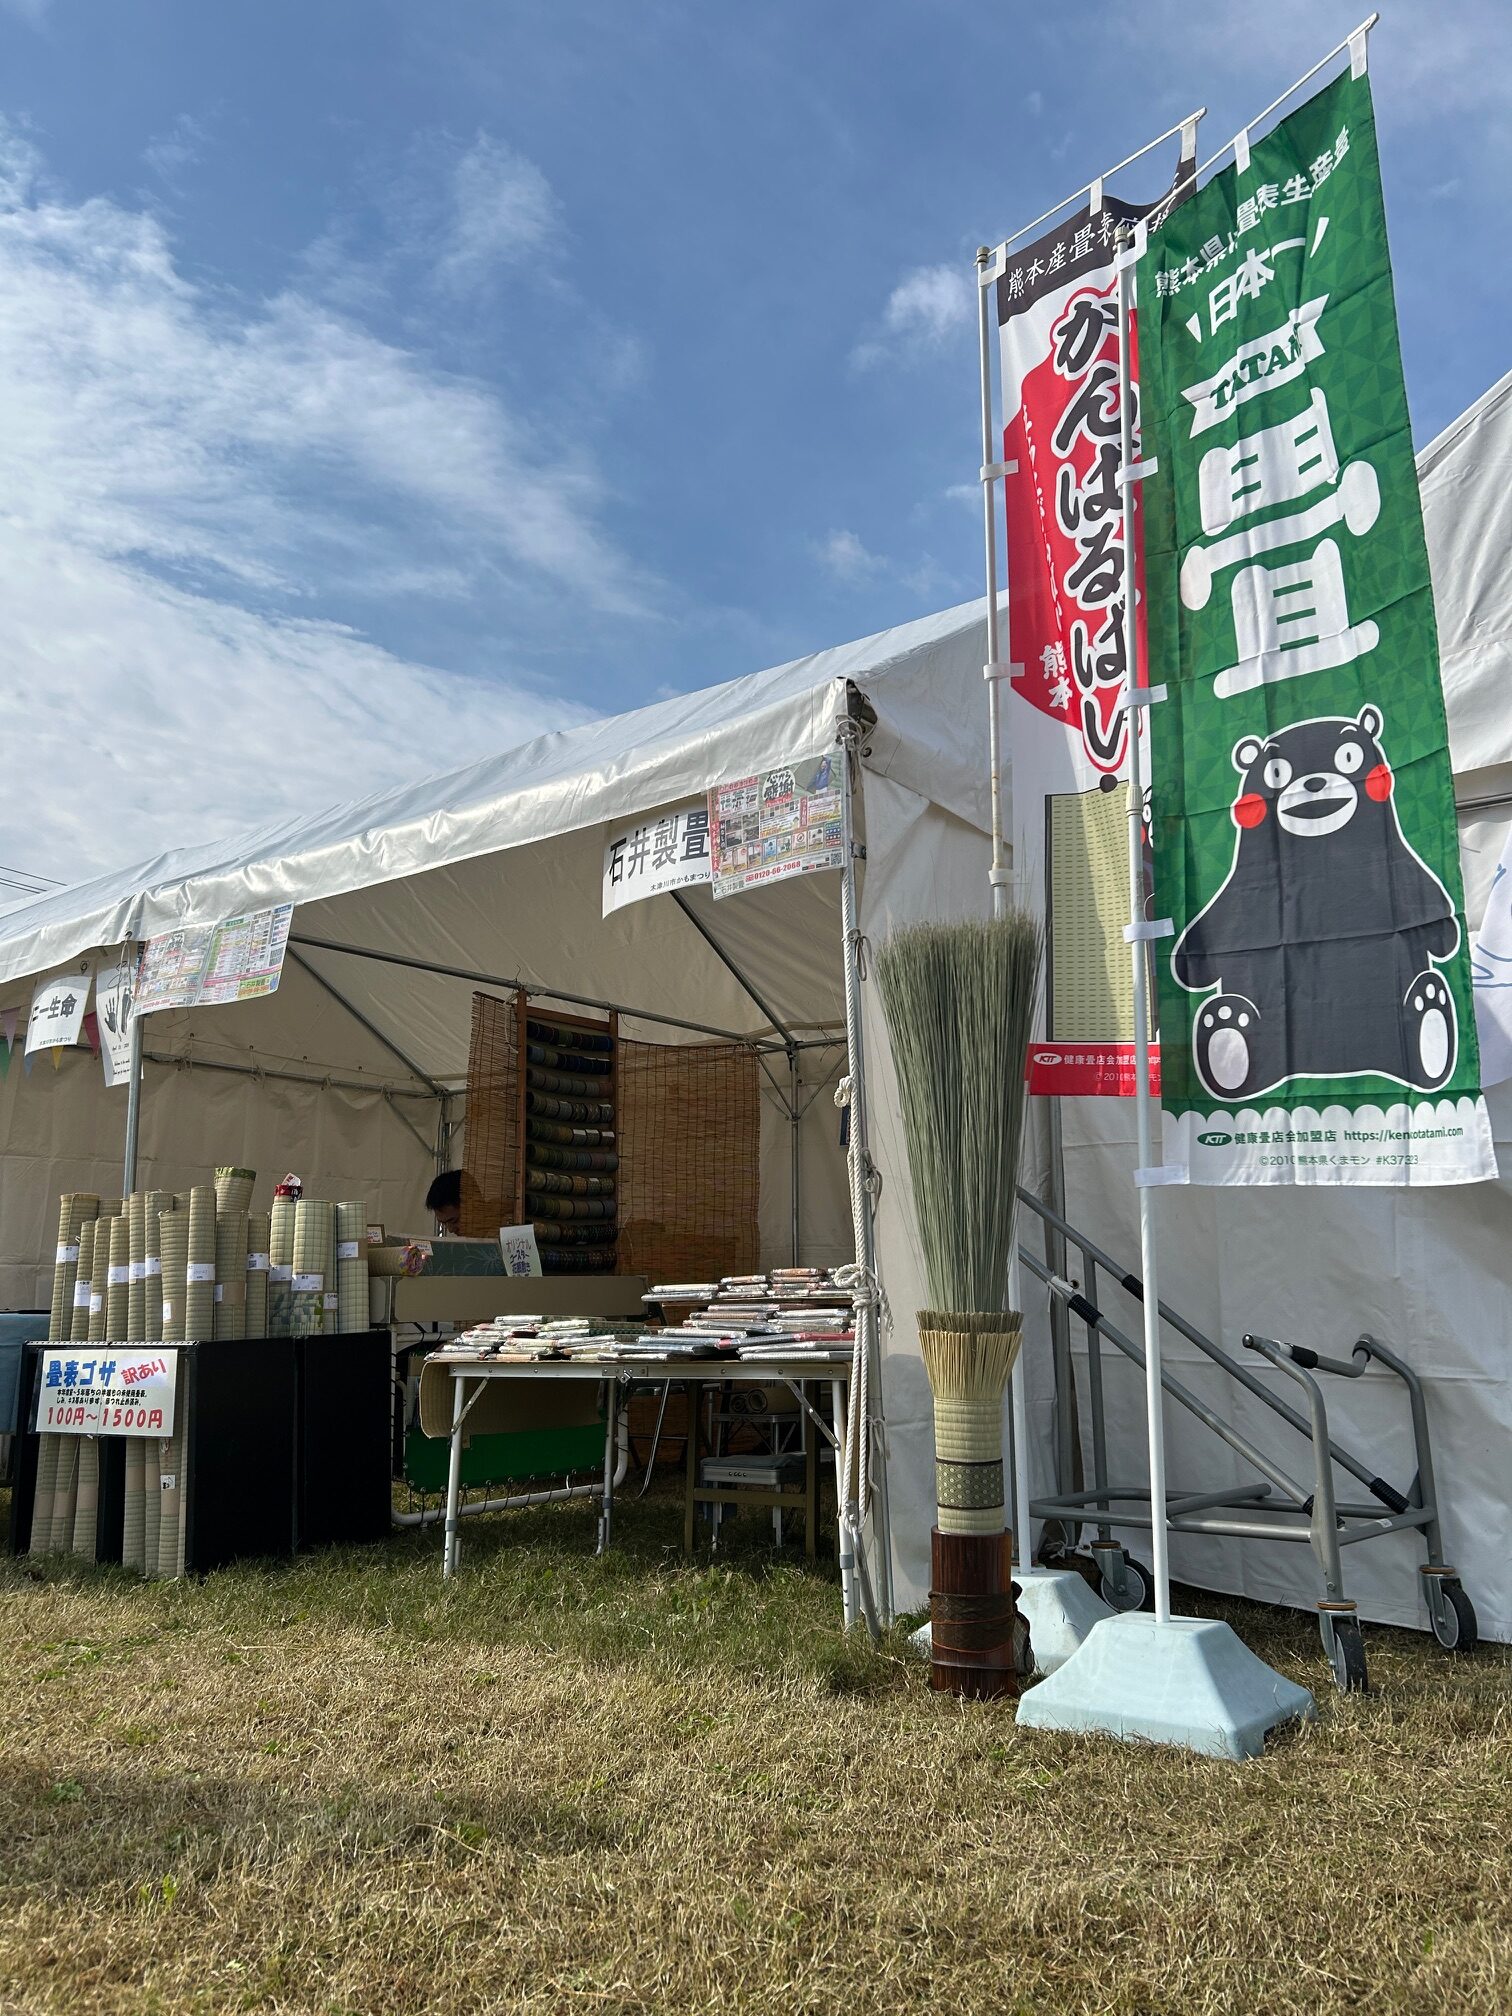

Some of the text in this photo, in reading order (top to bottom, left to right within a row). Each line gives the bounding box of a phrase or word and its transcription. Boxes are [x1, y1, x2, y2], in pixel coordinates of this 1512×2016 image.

[1208, 237, 1307, 336] 日本一
[1180, 387, 1381, 699] 畳
[1039, 640, 1073, 711] 熊本
[764, 778, 795, 801] 感謝
[609, 809, 710, 886] 石井製畳
[1234, 1130, 1337, 1145] 健康畳店会加盟店
[46, 1359, 117, 1388] 畳表ゴザ
[121, 1358, 168, 1385] 訳あり
